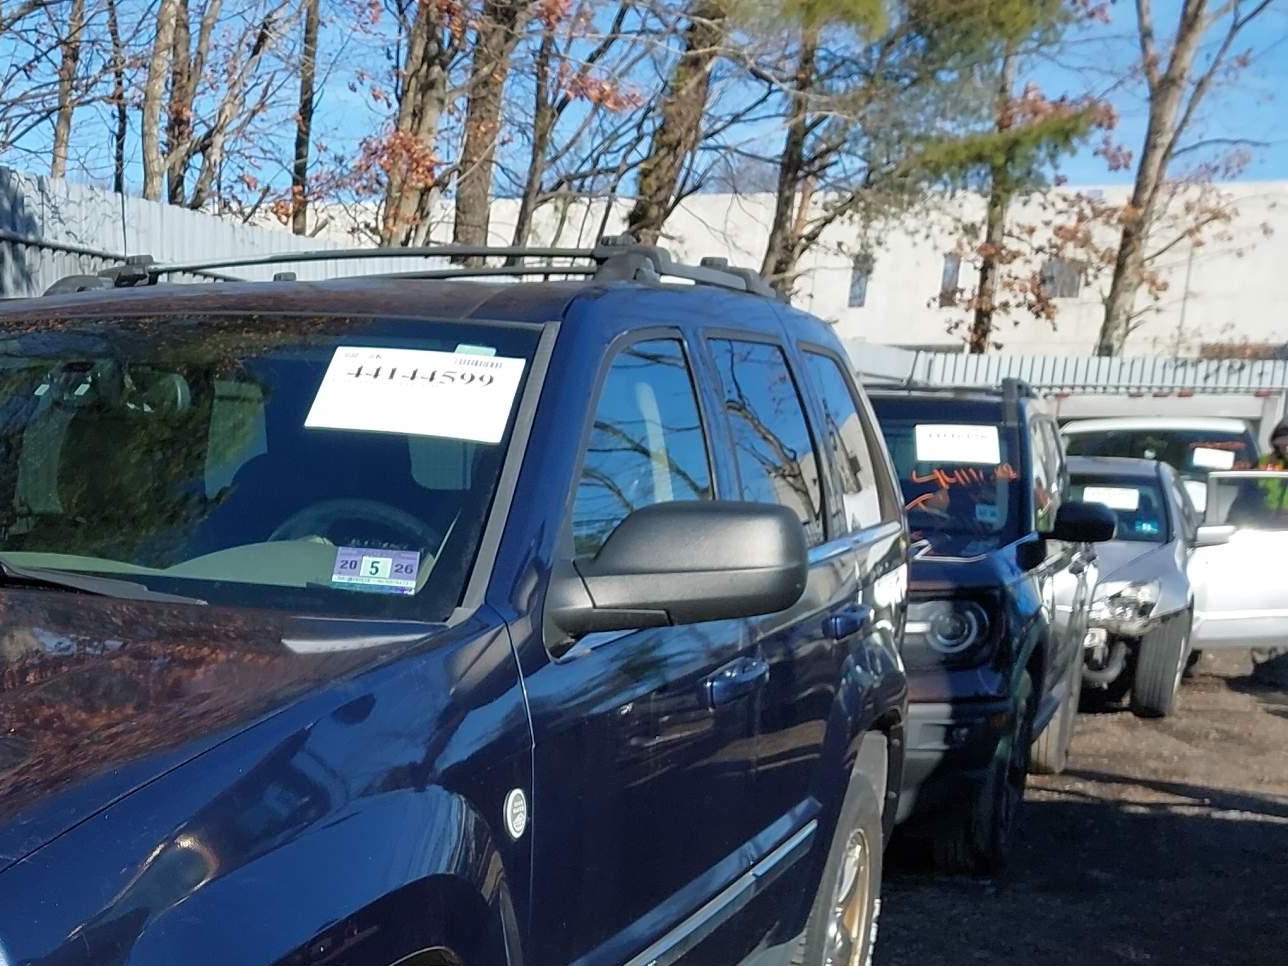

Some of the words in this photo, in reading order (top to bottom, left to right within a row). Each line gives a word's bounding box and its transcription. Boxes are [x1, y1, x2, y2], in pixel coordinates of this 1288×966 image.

[346, 364, 495, 387] 44144599
[340, 559, 358, 571] 20
[368, 560, 380, 576] 5
[394, 563, 414, 575] 26
